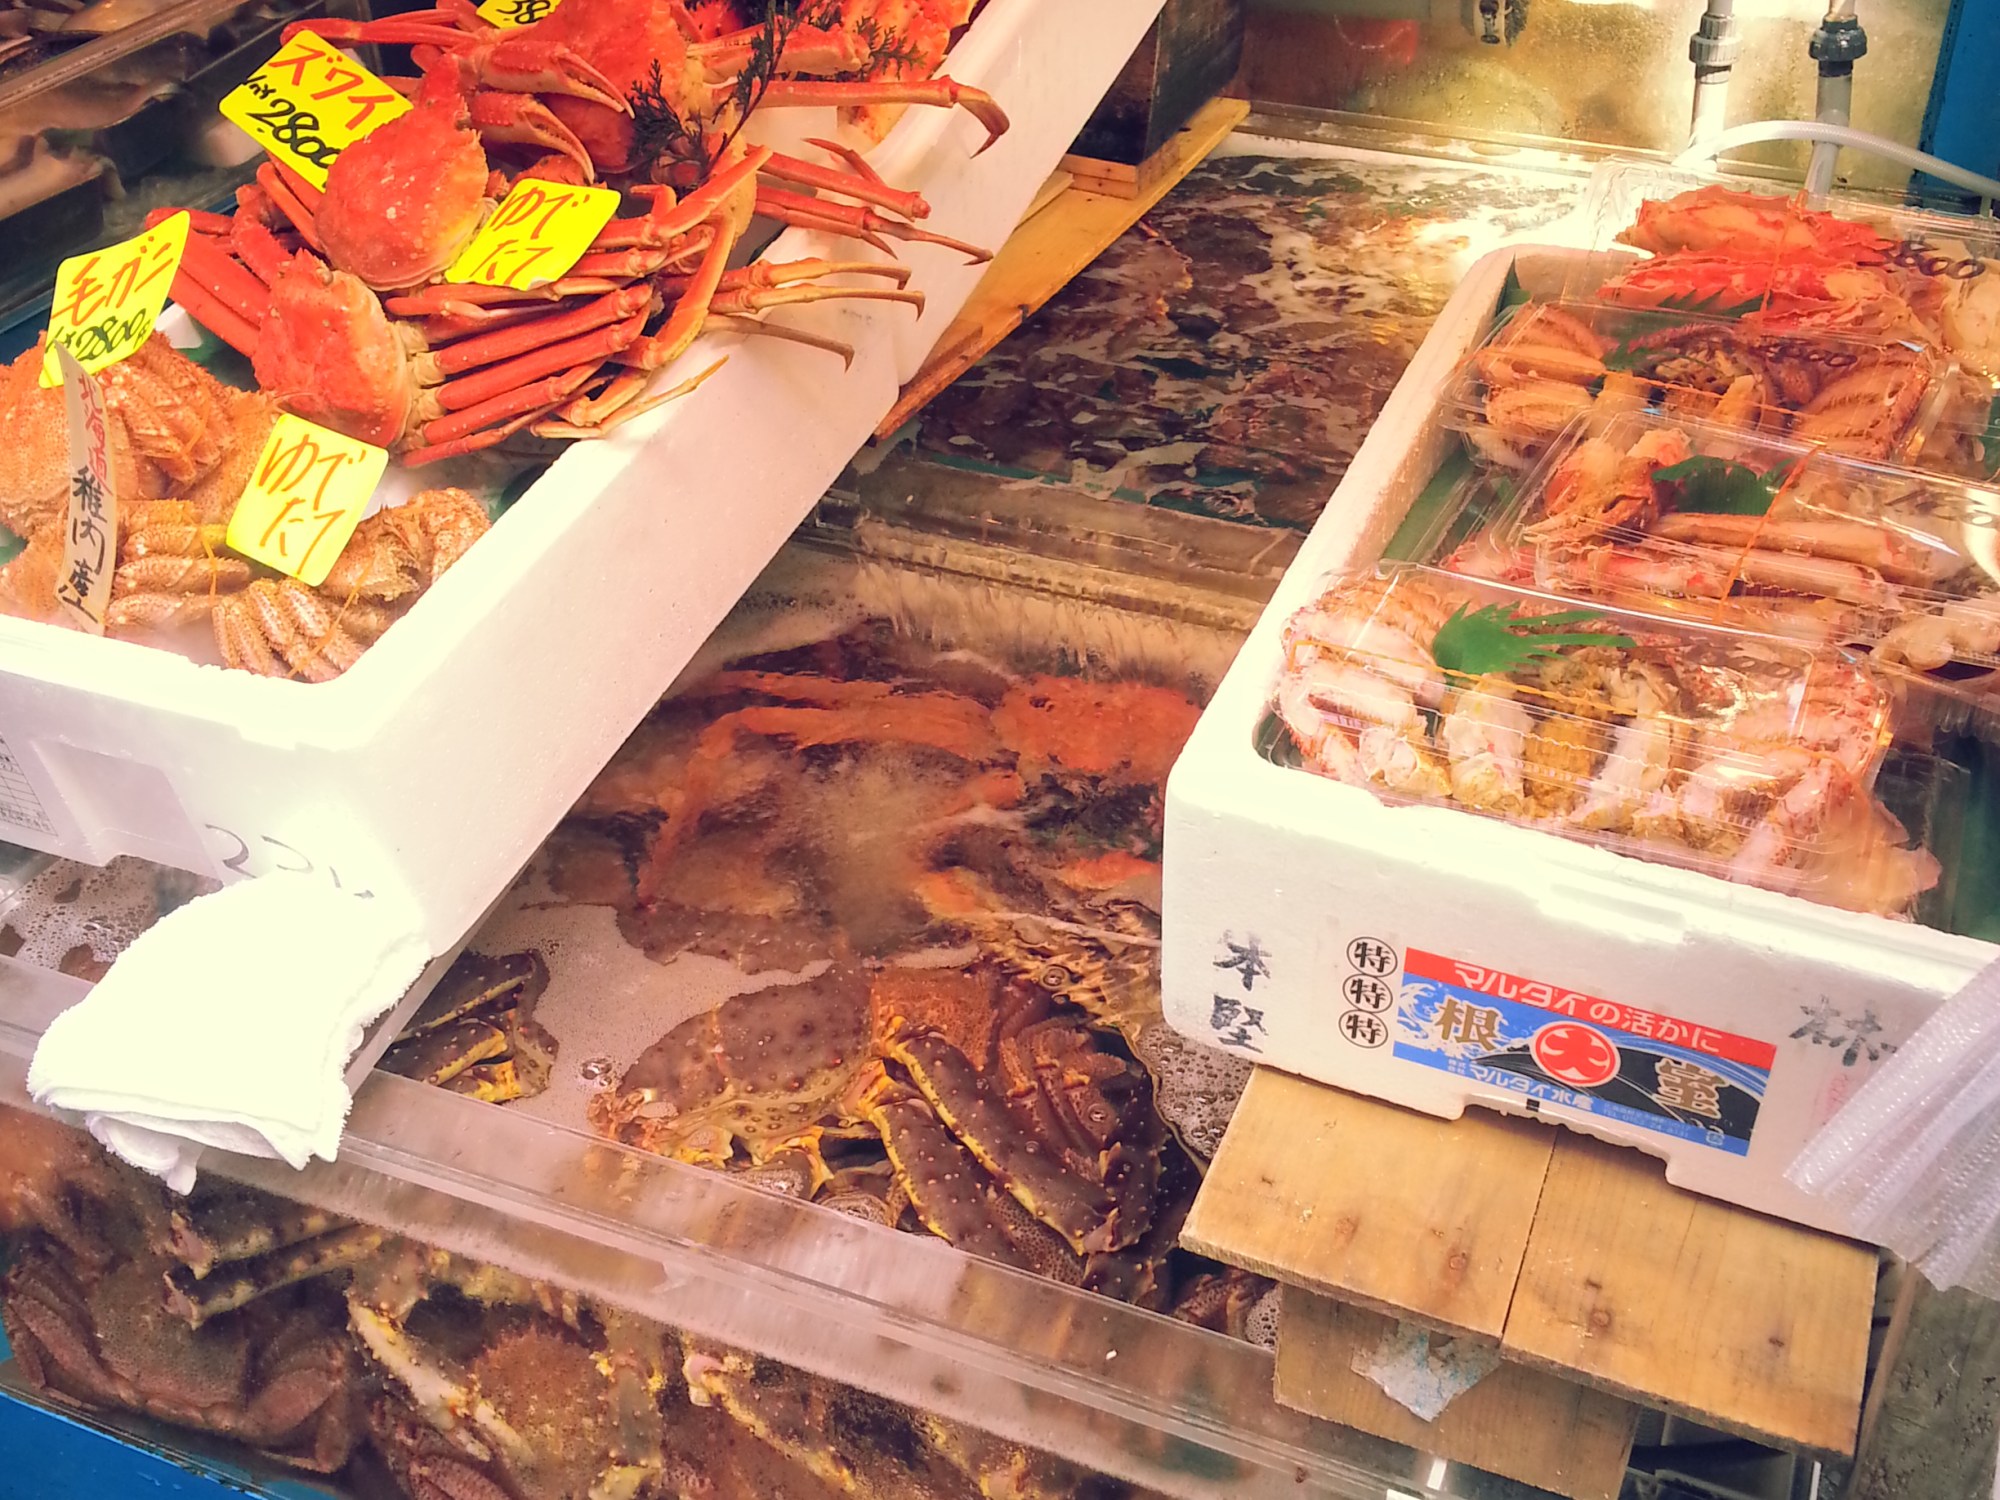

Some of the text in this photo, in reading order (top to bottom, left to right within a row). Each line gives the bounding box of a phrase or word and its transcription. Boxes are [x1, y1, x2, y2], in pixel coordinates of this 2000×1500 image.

[268, 44, 396, 131] ズワイ
[490, 186, 590, 240] ゆで
[51, 236, 174, 327] 毛ガニ
[469, 239, 554, 284] たて
[258, 433, 367, 512] ゆで
[259, 497, 346, 576] たて
[1454, 962, 1723, 1053] マルダイの活かに
